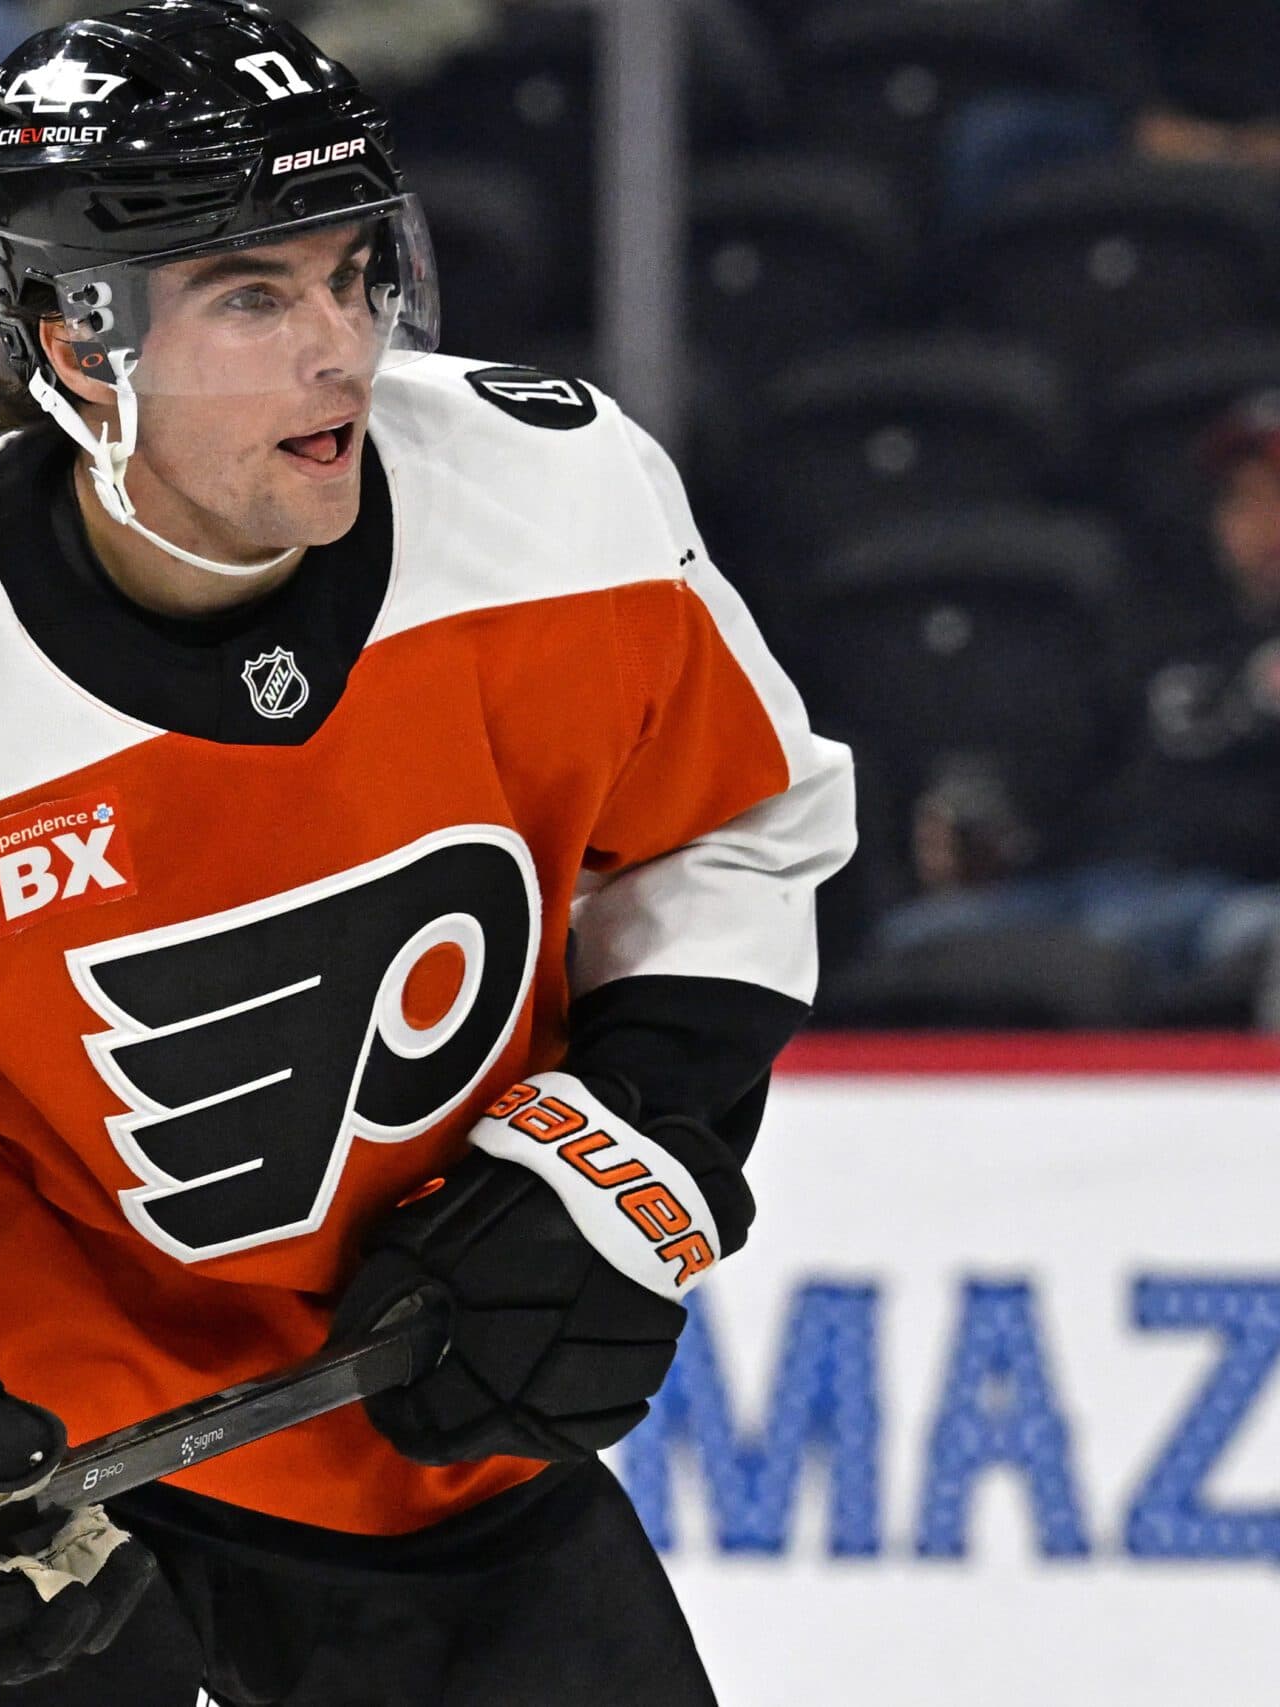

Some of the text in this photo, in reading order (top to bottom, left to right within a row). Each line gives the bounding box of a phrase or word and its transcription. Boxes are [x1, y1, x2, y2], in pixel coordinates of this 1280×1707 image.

[234, 50, 313, 100] 17
[271, 136, 367, 176] BAUER
[264, 665, 289, 708] NHL
[484, 1083, 716, 1288] BAUER
[193, 1427, 224, 1450] sigma
